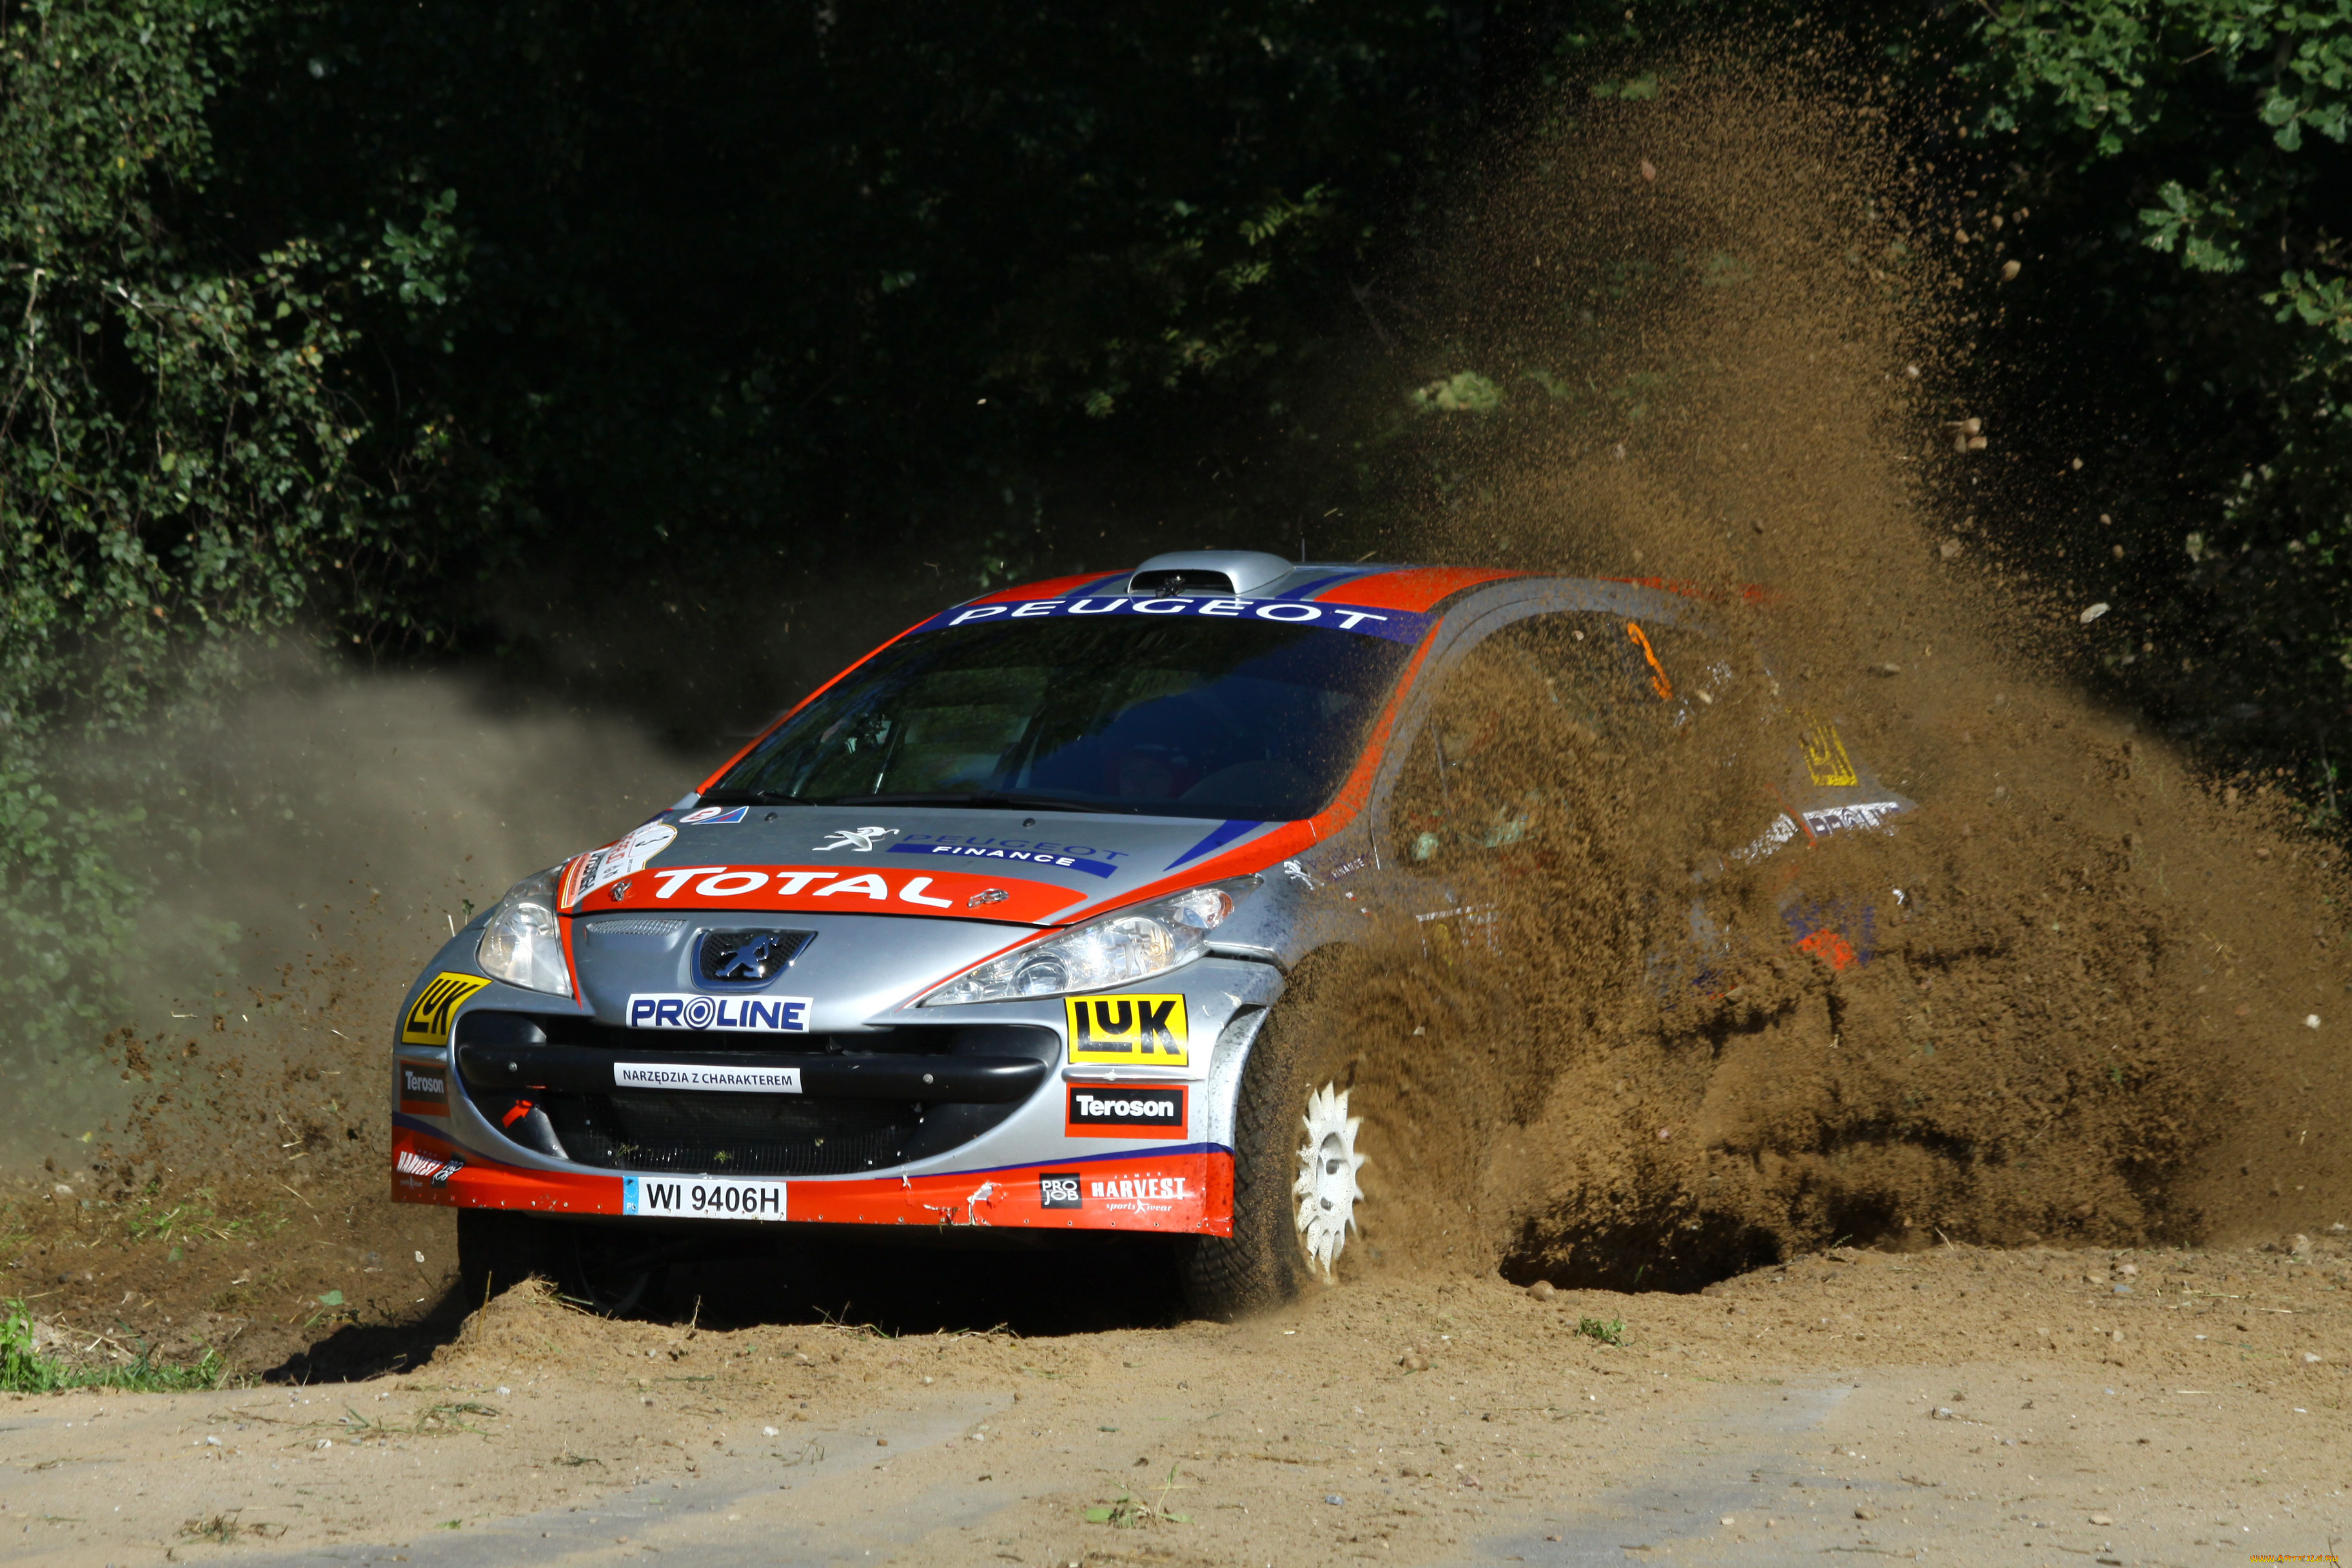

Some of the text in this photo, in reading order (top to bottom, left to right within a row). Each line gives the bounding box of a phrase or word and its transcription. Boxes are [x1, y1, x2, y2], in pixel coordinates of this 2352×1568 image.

[949, 598, 1388, 630] PEUGEOT
[902, 834, 1129, 861] PEUGEOT
[932, 846, 1075, 867] FINANCE
[654, 866, 953, 909] TOTAL
[406, 979, 481, 1036] LUK
[631, 996, 806, 1031] PROLINE
[1074, 1000, 1181, 1055] LUK
[405, 1071, 444, 1094] Teroson
[622, 1070, 793, 1086] NARZĘDZIA Z CHARAKTEREM
[1076, 1095, 1174, 1117] Teroson
[397, 1151, 444, 1176] HARVEST
[1113, 1171, 1162, 1179] JAMES
[647, 1183, 779, 1213] WI 9406H
[1042, 1180, 1078, 1192] PRO
[1044, 1190, 1079, 1205] JOB
[1091, 1177, 1186, 1200] HARVEST
